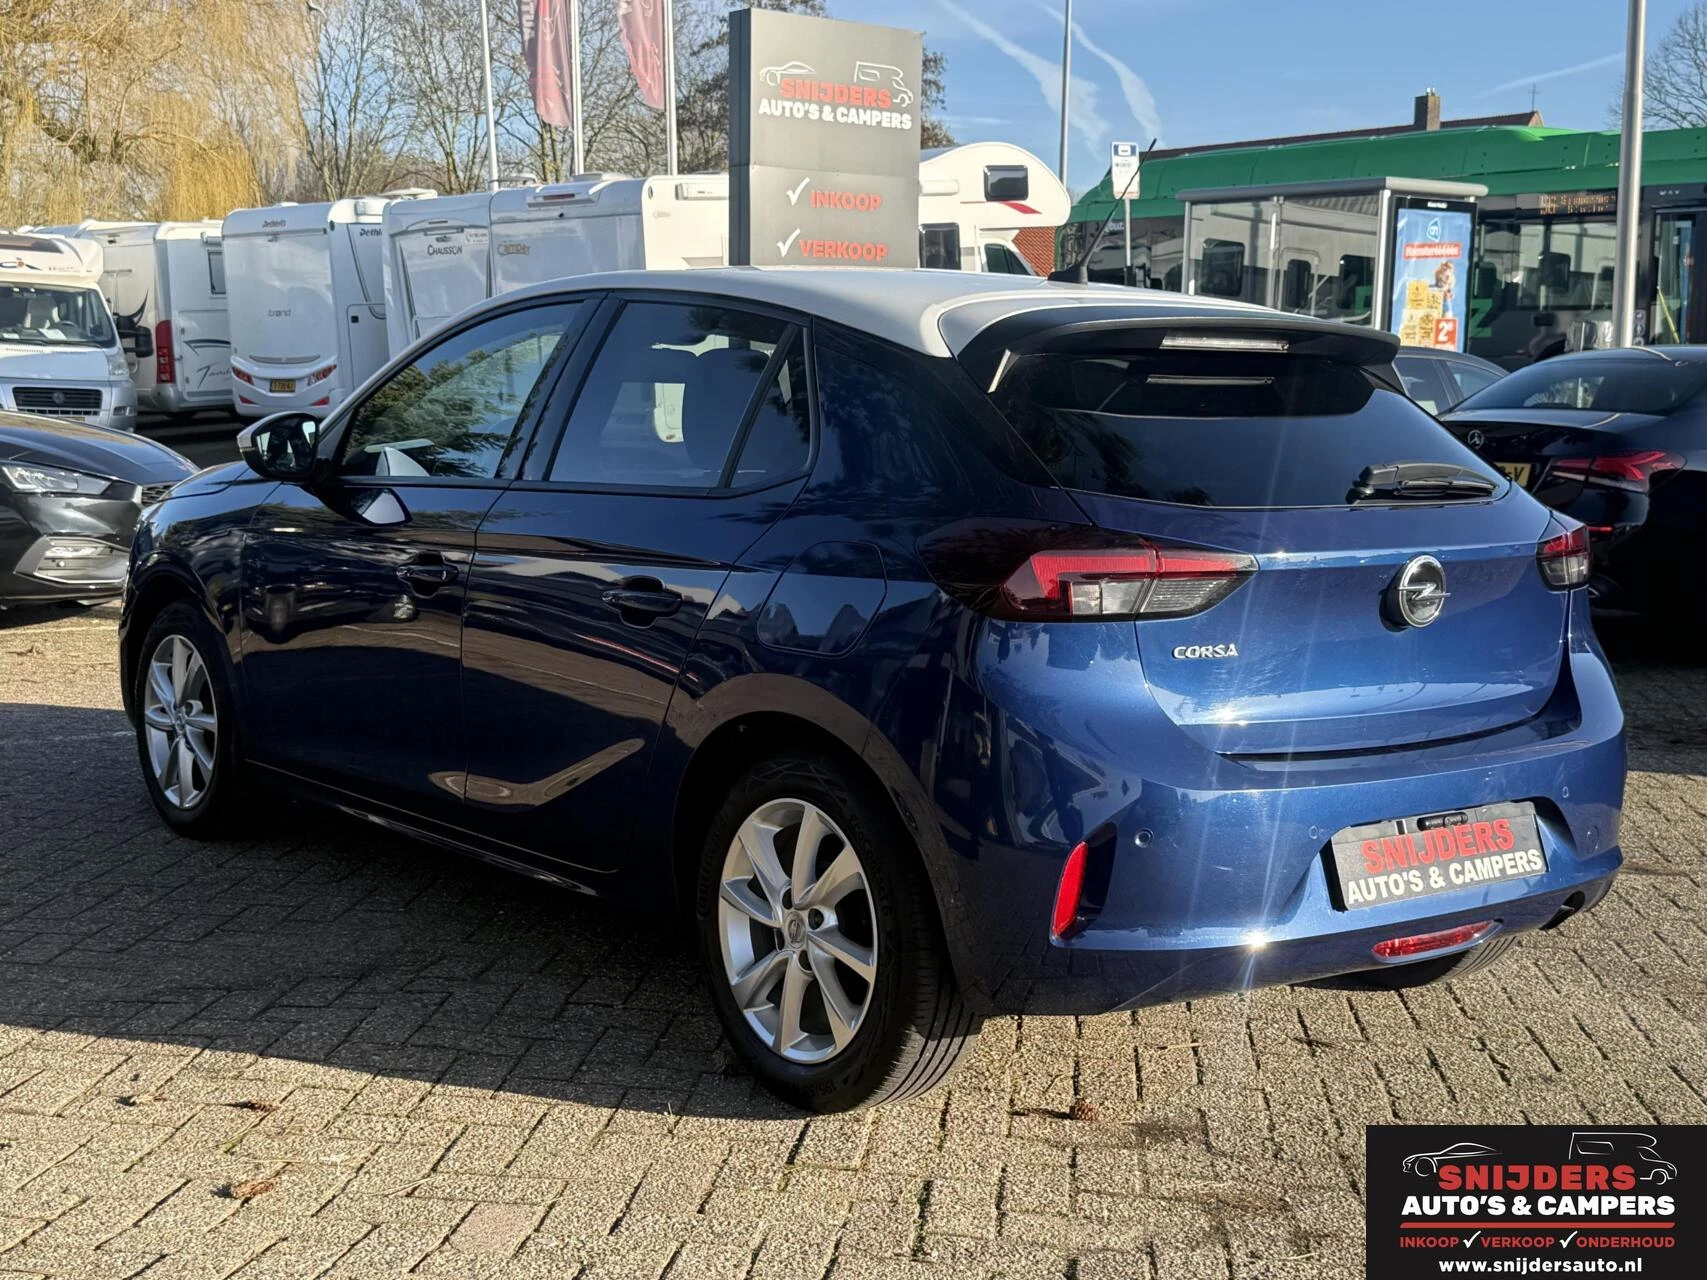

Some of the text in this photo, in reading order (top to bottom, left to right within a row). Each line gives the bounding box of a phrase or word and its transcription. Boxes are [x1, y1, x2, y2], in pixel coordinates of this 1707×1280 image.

[780, 78, 892, 109] SNIJDERS
[758, 98, 912, 130] AUTO'S & CAMPERS
[810, 190, 881, 212] INKOOP
[799, 239, 889, 261] VERKOOP
[1172, 643, 1238, 660] CORSA
[1360, 818, 1515, 873] SNIJDERS
[1347, 849, 1542, 904] AUTO'S & CAMPERS
